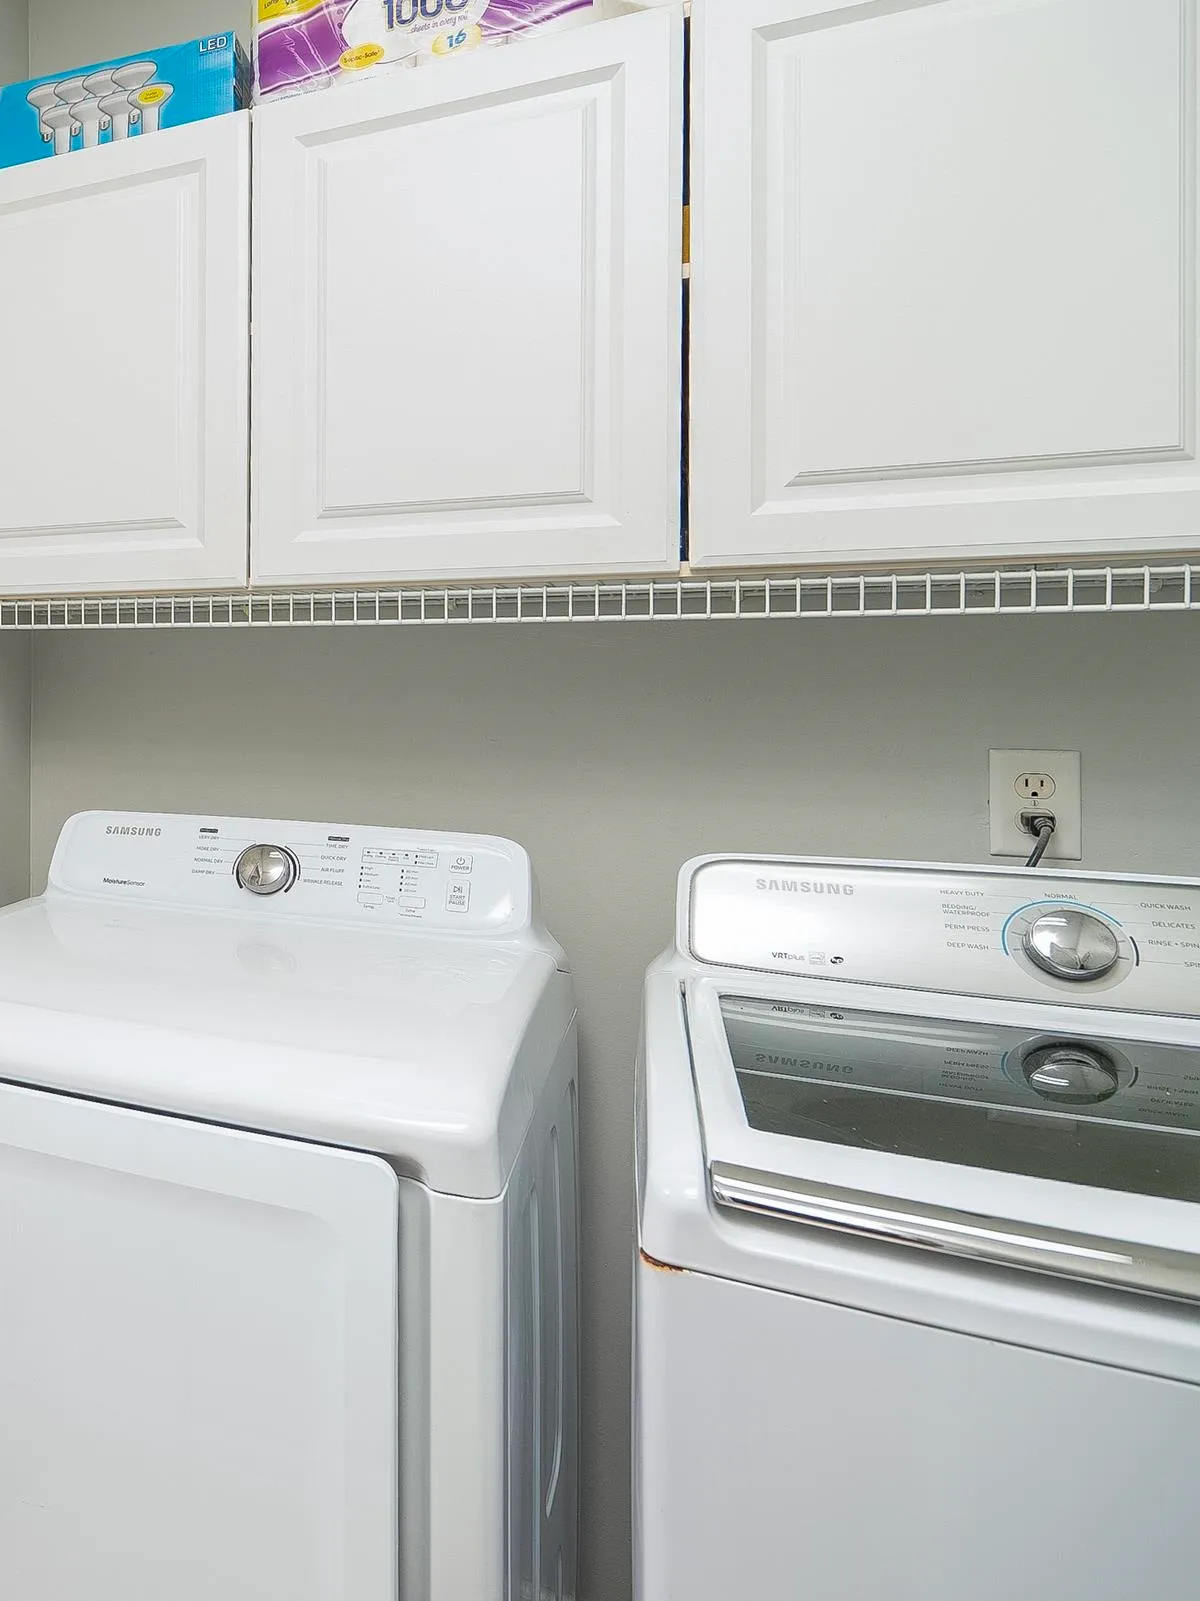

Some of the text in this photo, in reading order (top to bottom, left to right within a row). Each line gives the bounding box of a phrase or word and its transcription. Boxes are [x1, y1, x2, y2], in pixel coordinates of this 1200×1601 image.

[447, 29, 467, 48] 16
[200, 36, 227, 52] LED
[105, 825, 162, 837] SAMSUNG
[756, 878, 853, 896] SAMSUNG
[1043, 892, 1079, 901] NORMAL
[1140, 902, 1192, 912] QUICK WASH
[1151, 920, 1196, 930] DELICATES
[946, 941, 967, 949] DEEP
[1147, 939, 1173, 947] RINSE
[1179, 941, 1200, 949] SPIN
